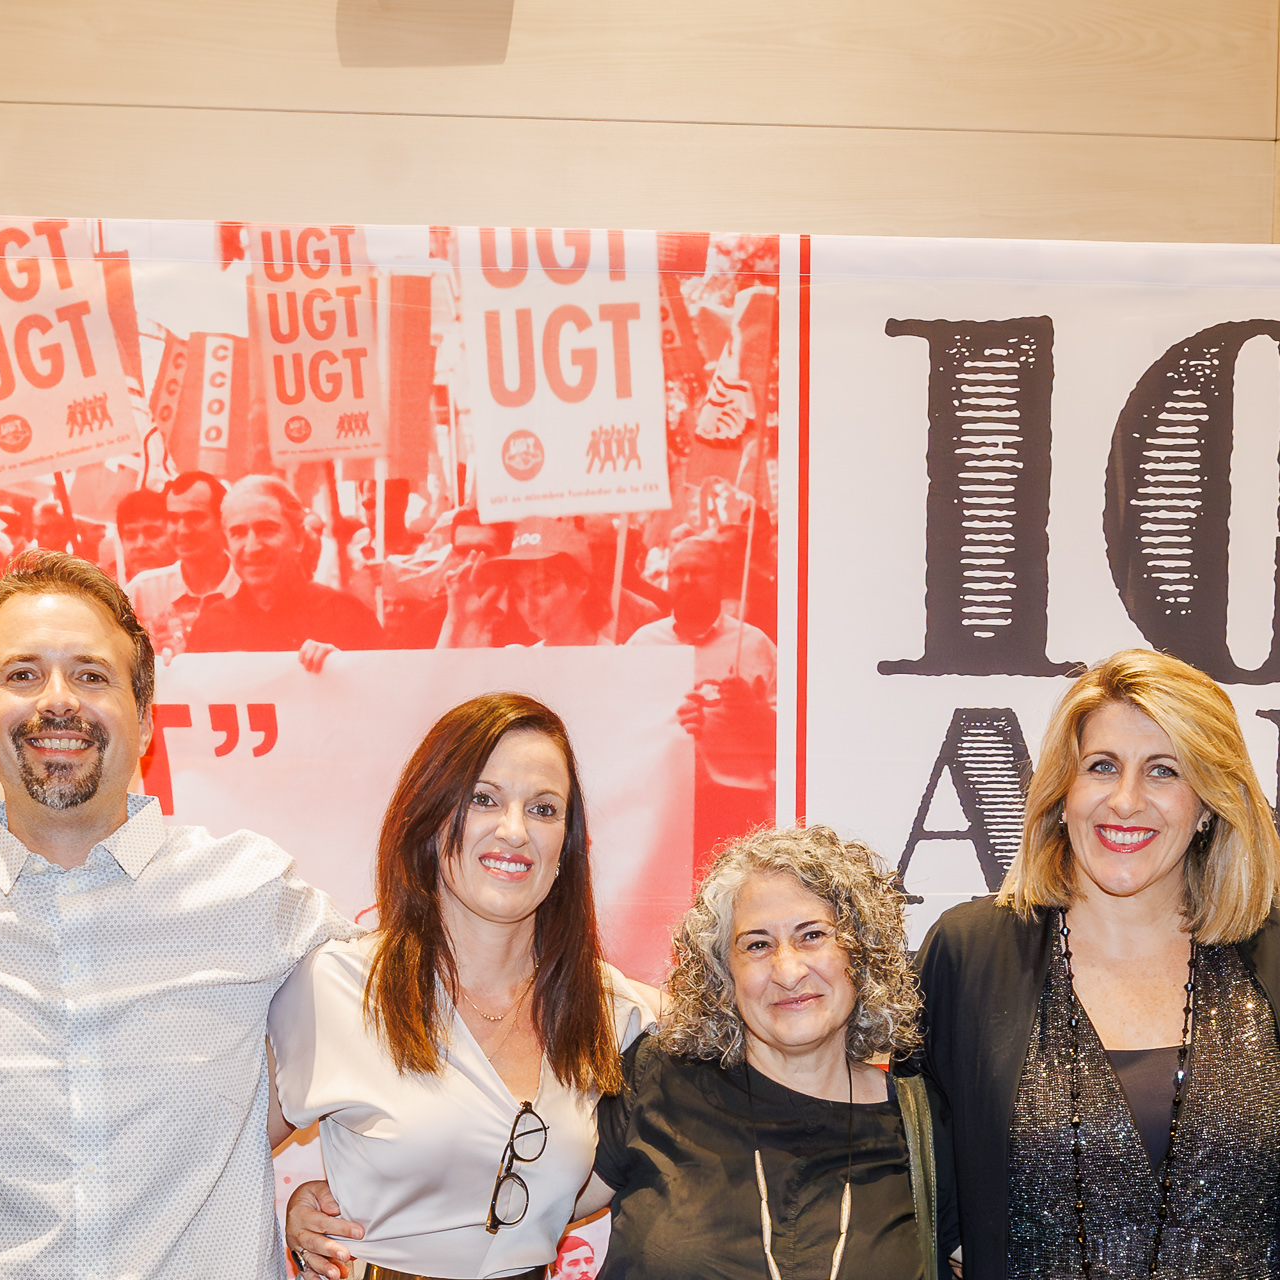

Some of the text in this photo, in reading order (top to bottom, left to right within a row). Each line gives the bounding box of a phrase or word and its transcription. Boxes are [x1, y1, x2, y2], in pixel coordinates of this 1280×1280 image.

[261, 225, 356, 282] UGT
[267, 285, 362, 344] UGT
[273, 347, 368, 405] UGT
[484, 302, 640, 408] UGT
[159, 352, 186, 422] CCO
